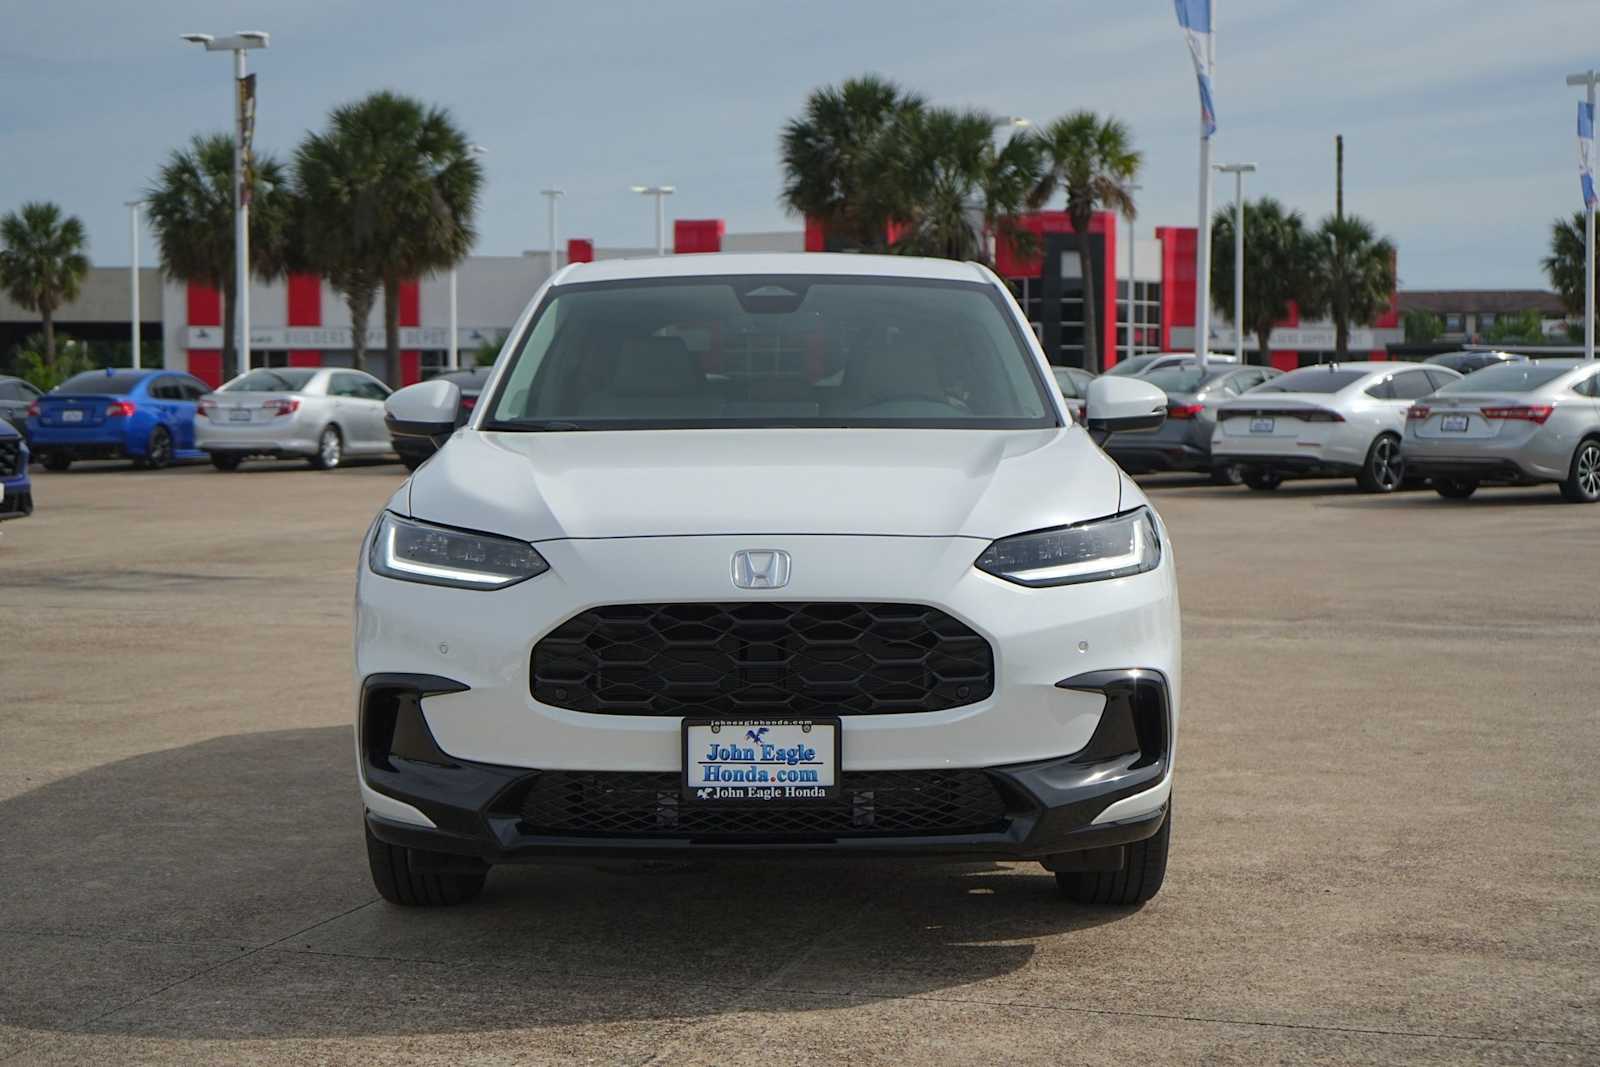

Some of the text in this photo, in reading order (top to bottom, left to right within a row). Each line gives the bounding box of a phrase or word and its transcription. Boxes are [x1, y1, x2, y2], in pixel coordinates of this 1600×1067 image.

[706, 743, 816, 765] John Eagle
[702, 765, 818, 782] Honda.com
[713, 786, 826, 800] John Eagle Honda
